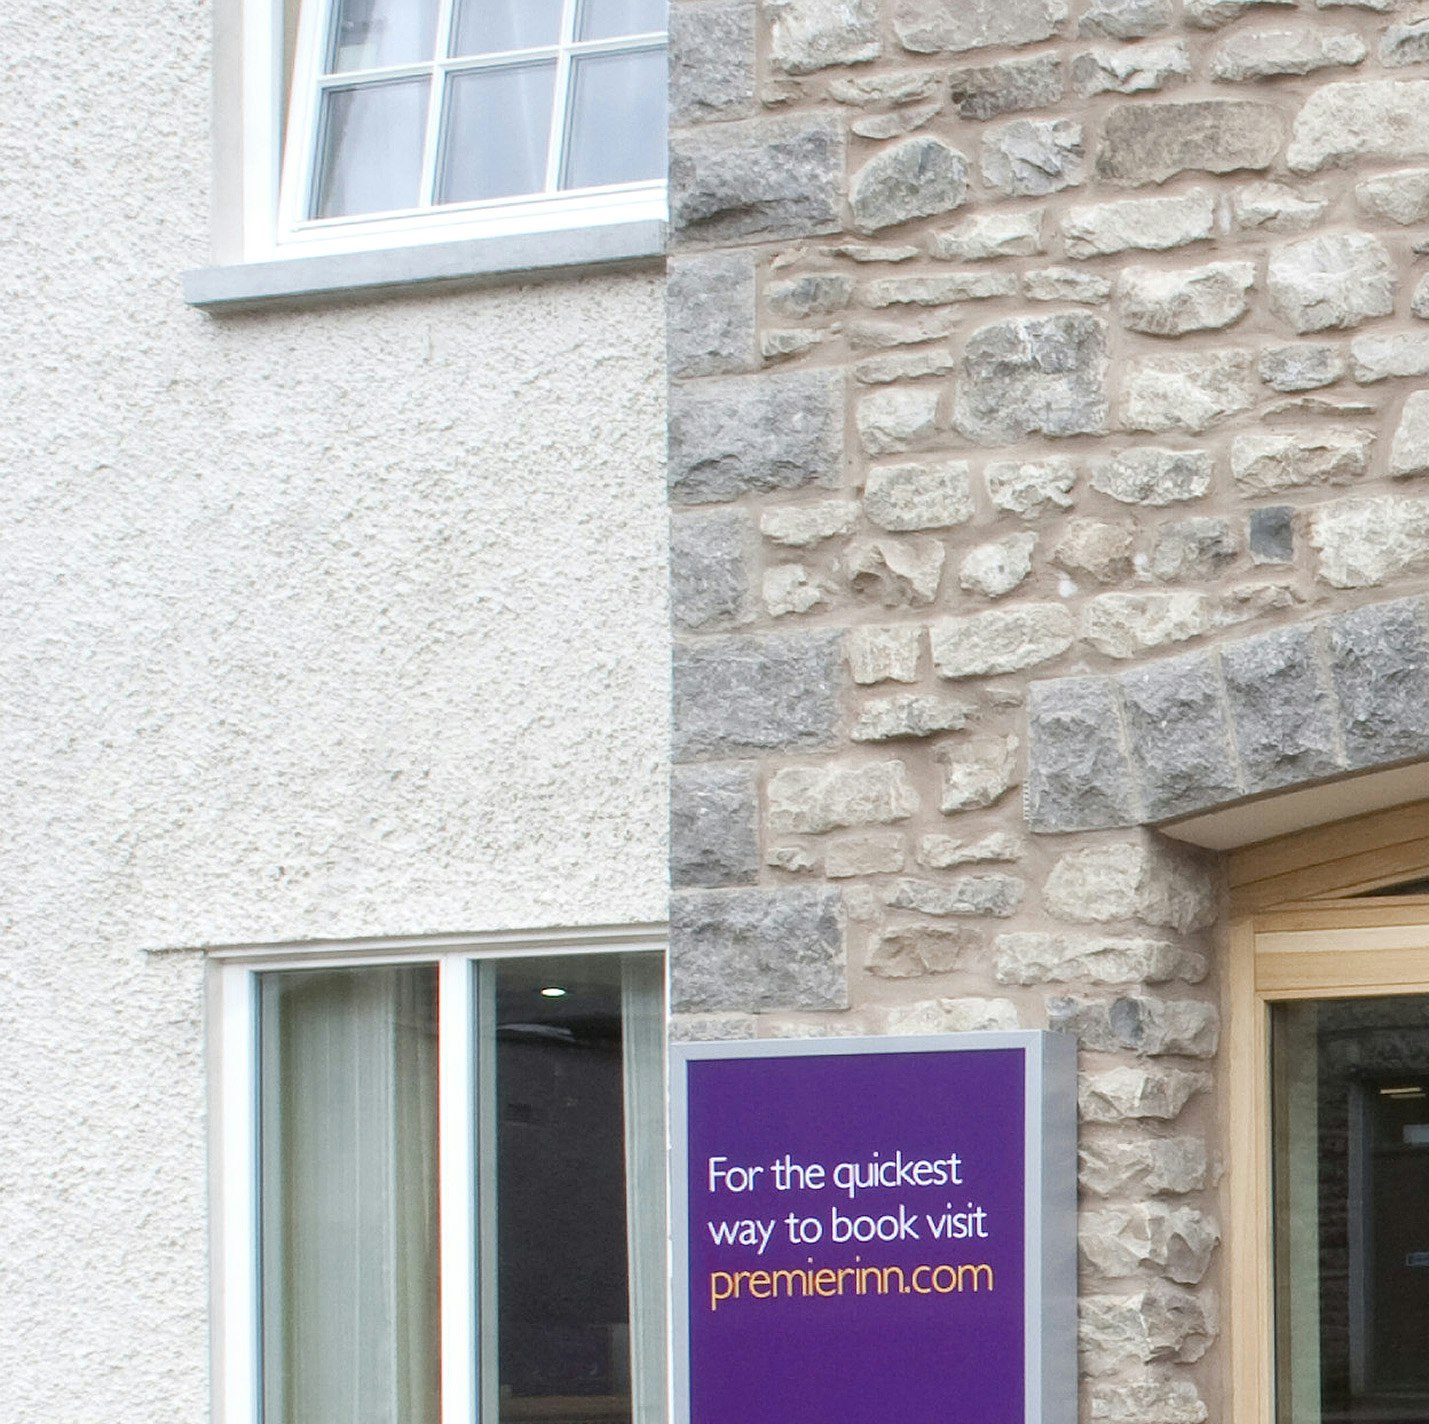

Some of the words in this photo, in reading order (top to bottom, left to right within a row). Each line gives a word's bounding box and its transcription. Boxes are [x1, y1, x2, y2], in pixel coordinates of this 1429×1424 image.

[708, 1156, 765, 1193] For
[769, 1154, 826, 1191] the
[833, 1150, 964, 1199] quickest
[707, 1218, 776, 1256] way
[784, 1212, 823, 1244] to
[831, 1204, 920, 1243] book
[926, 1202, 989, 1240] visit
[709, 1255, 994, 1312] premierinn.com
